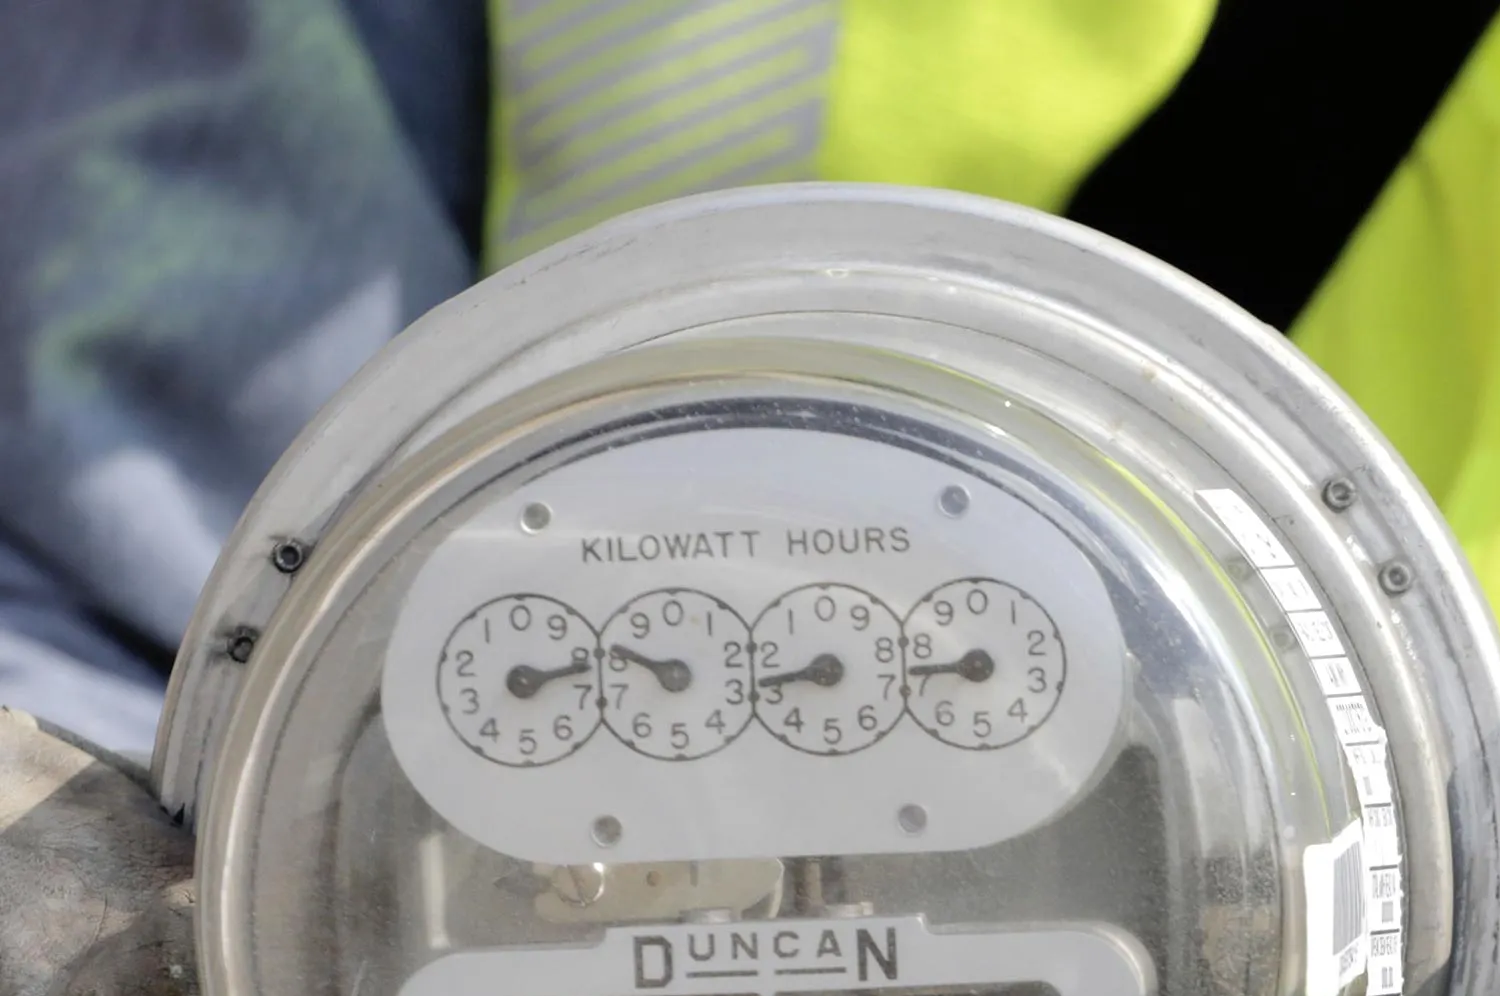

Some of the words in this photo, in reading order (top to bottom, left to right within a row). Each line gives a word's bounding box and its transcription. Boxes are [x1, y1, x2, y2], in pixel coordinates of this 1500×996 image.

[581, 530, 761, 564] KILOWATT
[786, 526, 911, 556] HOURS
[662, 600, 684, 627] 0
[814, 595, 836, 622] 0
[934, 600, 954, 626] 9
[966, 588, 988, 615] 0
[509, 604, 532, 632] 0
[547, 614, 568, 640] 9
[630, 612, 650, 639] 9
[850, 605, 870, 631] 9
[724, 641, 744, 668] 2
[760, 641, 780, 668] 2
[875, 637, 894, 663] 8
[912, 632, 932, 659] 8
[1027, 630, 1047, 656] 2
[456, 650, 477, 677] 2
[725, 679, 744, 705] 3
[877, 673, 896, 700] 7
[1027, 666, 1047, 693] 3
[461, 688, 480, 714] 3
[573, 684, 592, 710] 7
[609, 684, 629, 710] 7
[1007, 697, 1028, 723] 4
[632, 712, 652, 738] 6
[705, 709, 726, 735] 4
[783, 706, 805, 733] 4
[858, 704, 878, 731] 6
[934, 700, 955, 727] 6
[973, 711, 992, 738] 5
[479, 717, 501, 743] 4
[553, 714, 573, 741] 6
[671, 722, 690, 749] 5
[824, 718, 842, 745] 5
[519, 729, 537, 755] 5
[633, 926, 898, 989] DUNCAN
